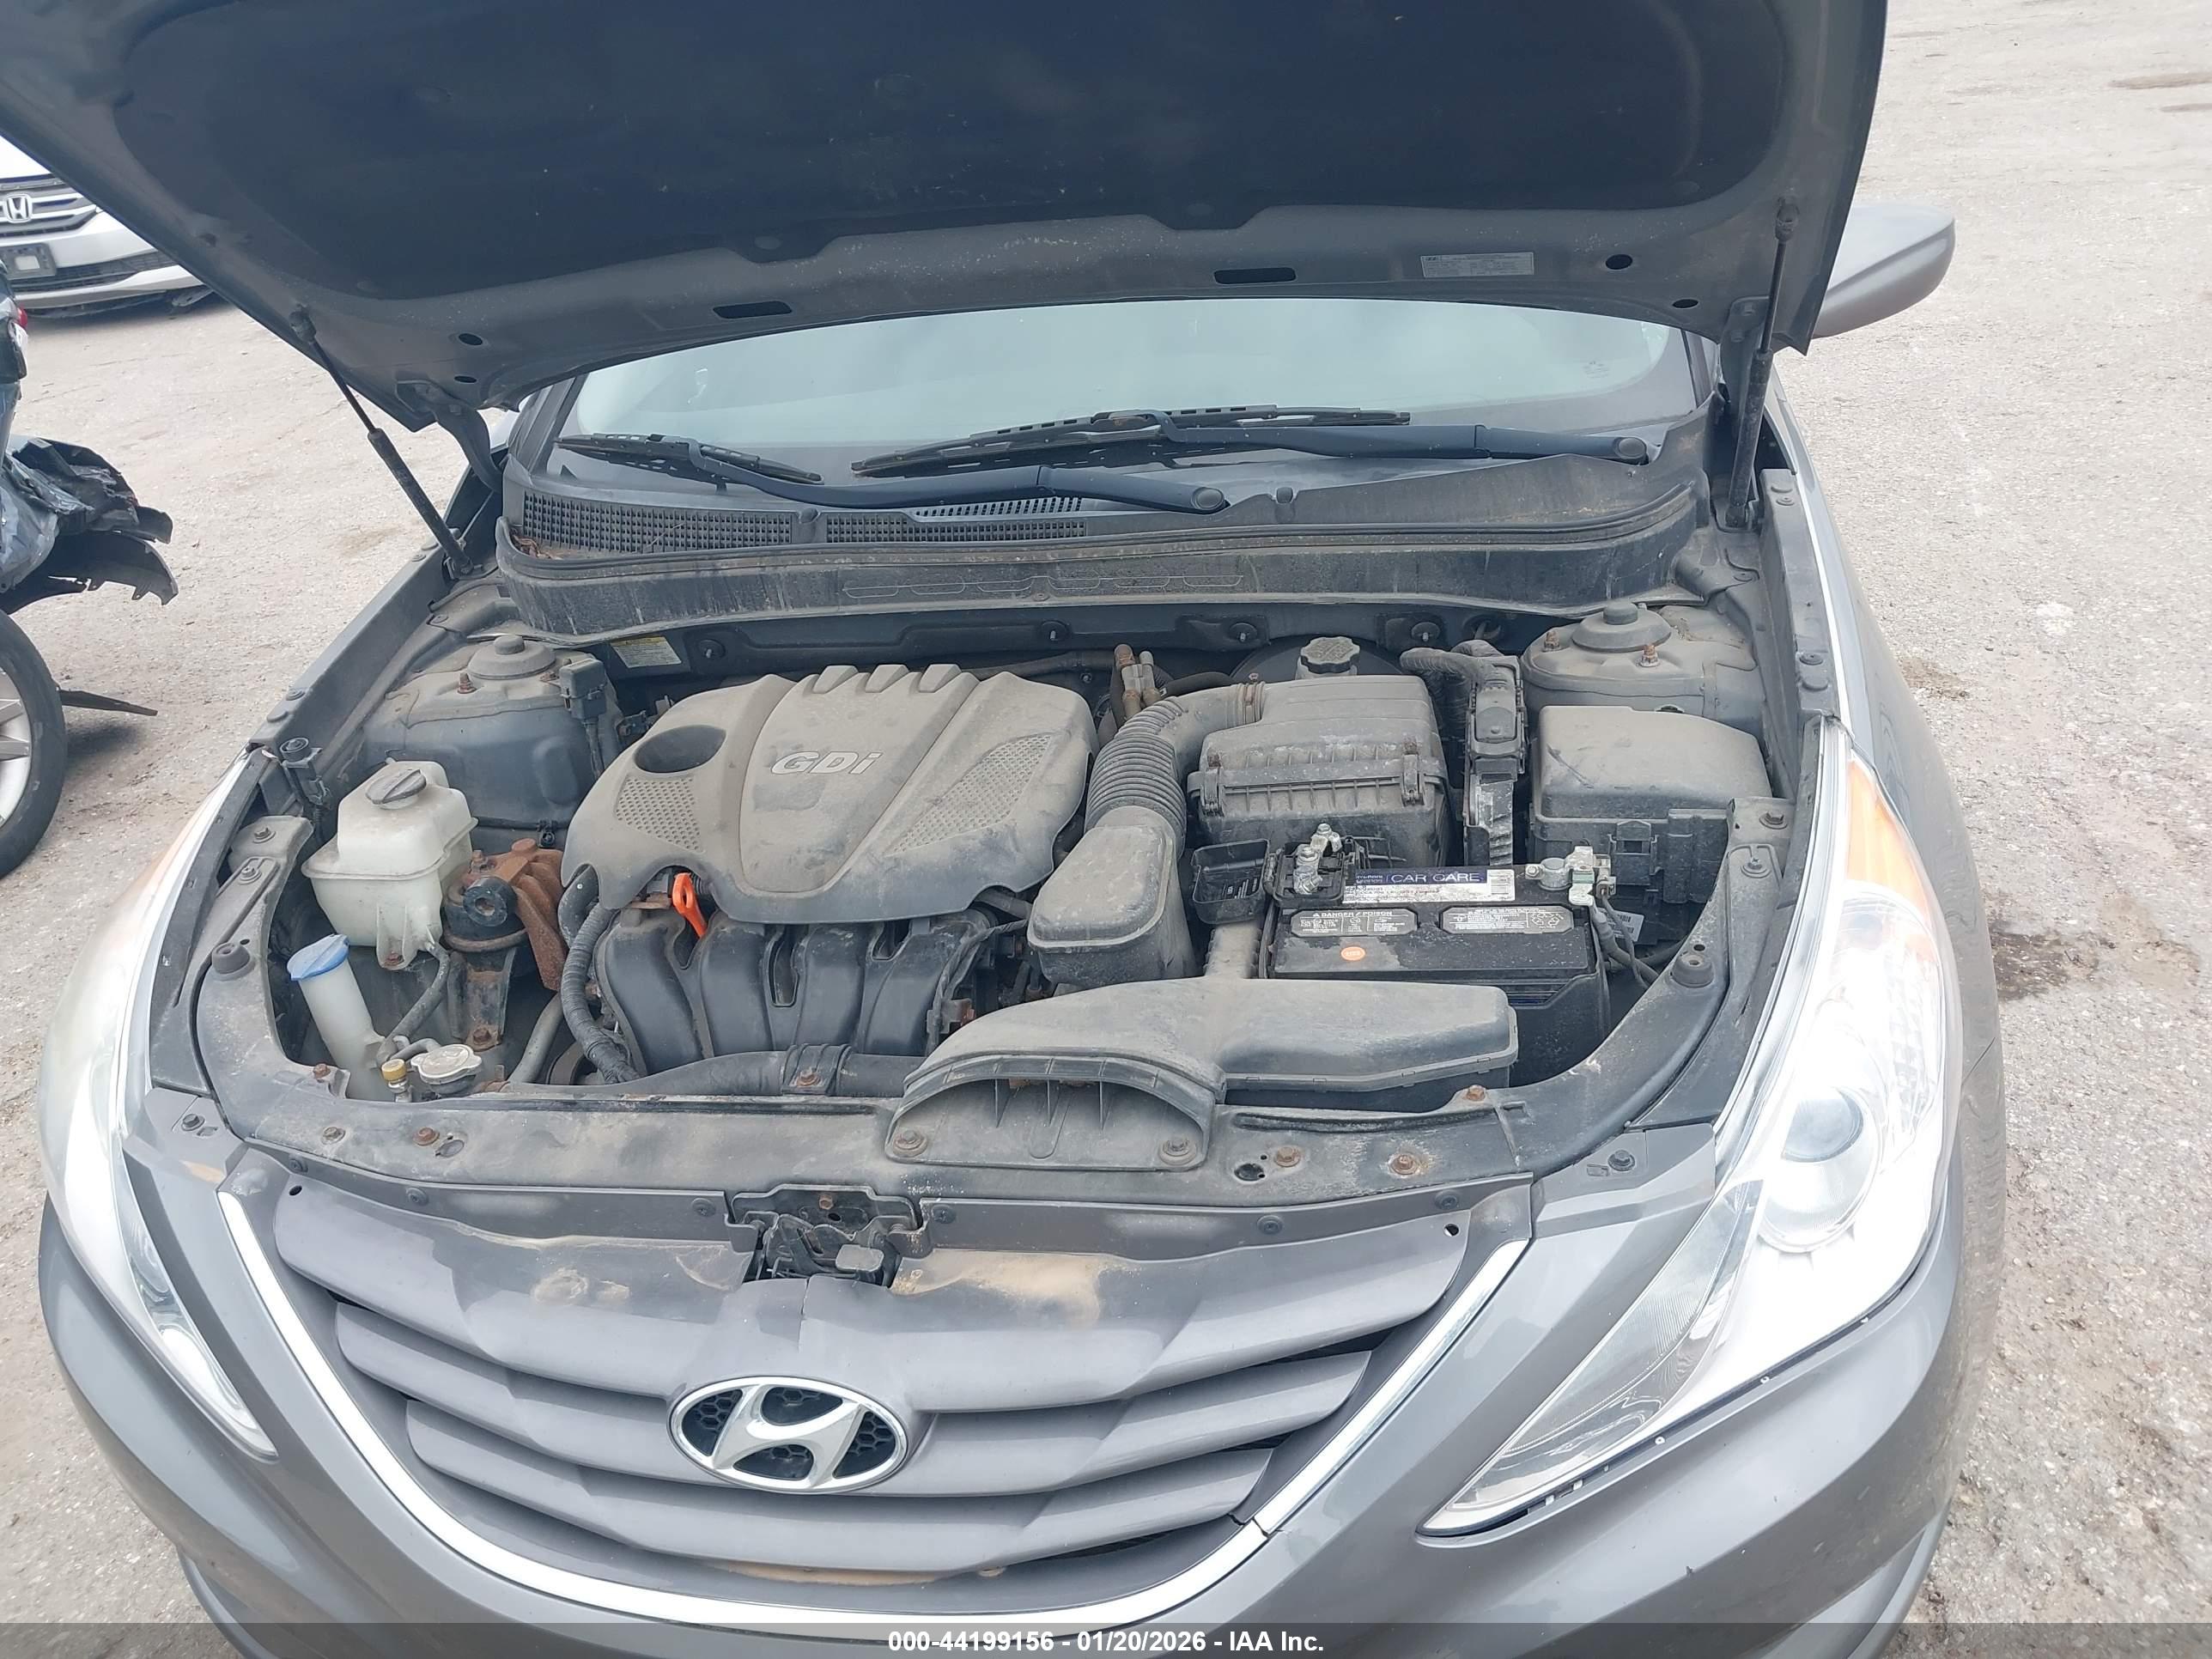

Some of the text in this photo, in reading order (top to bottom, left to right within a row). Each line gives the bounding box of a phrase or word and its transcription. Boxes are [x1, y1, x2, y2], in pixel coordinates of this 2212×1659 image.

[770, 750, 884, 775] GDi
[1390, 873, 1427, 884] CAR
[1432, 872, 1481, 882] CARE
